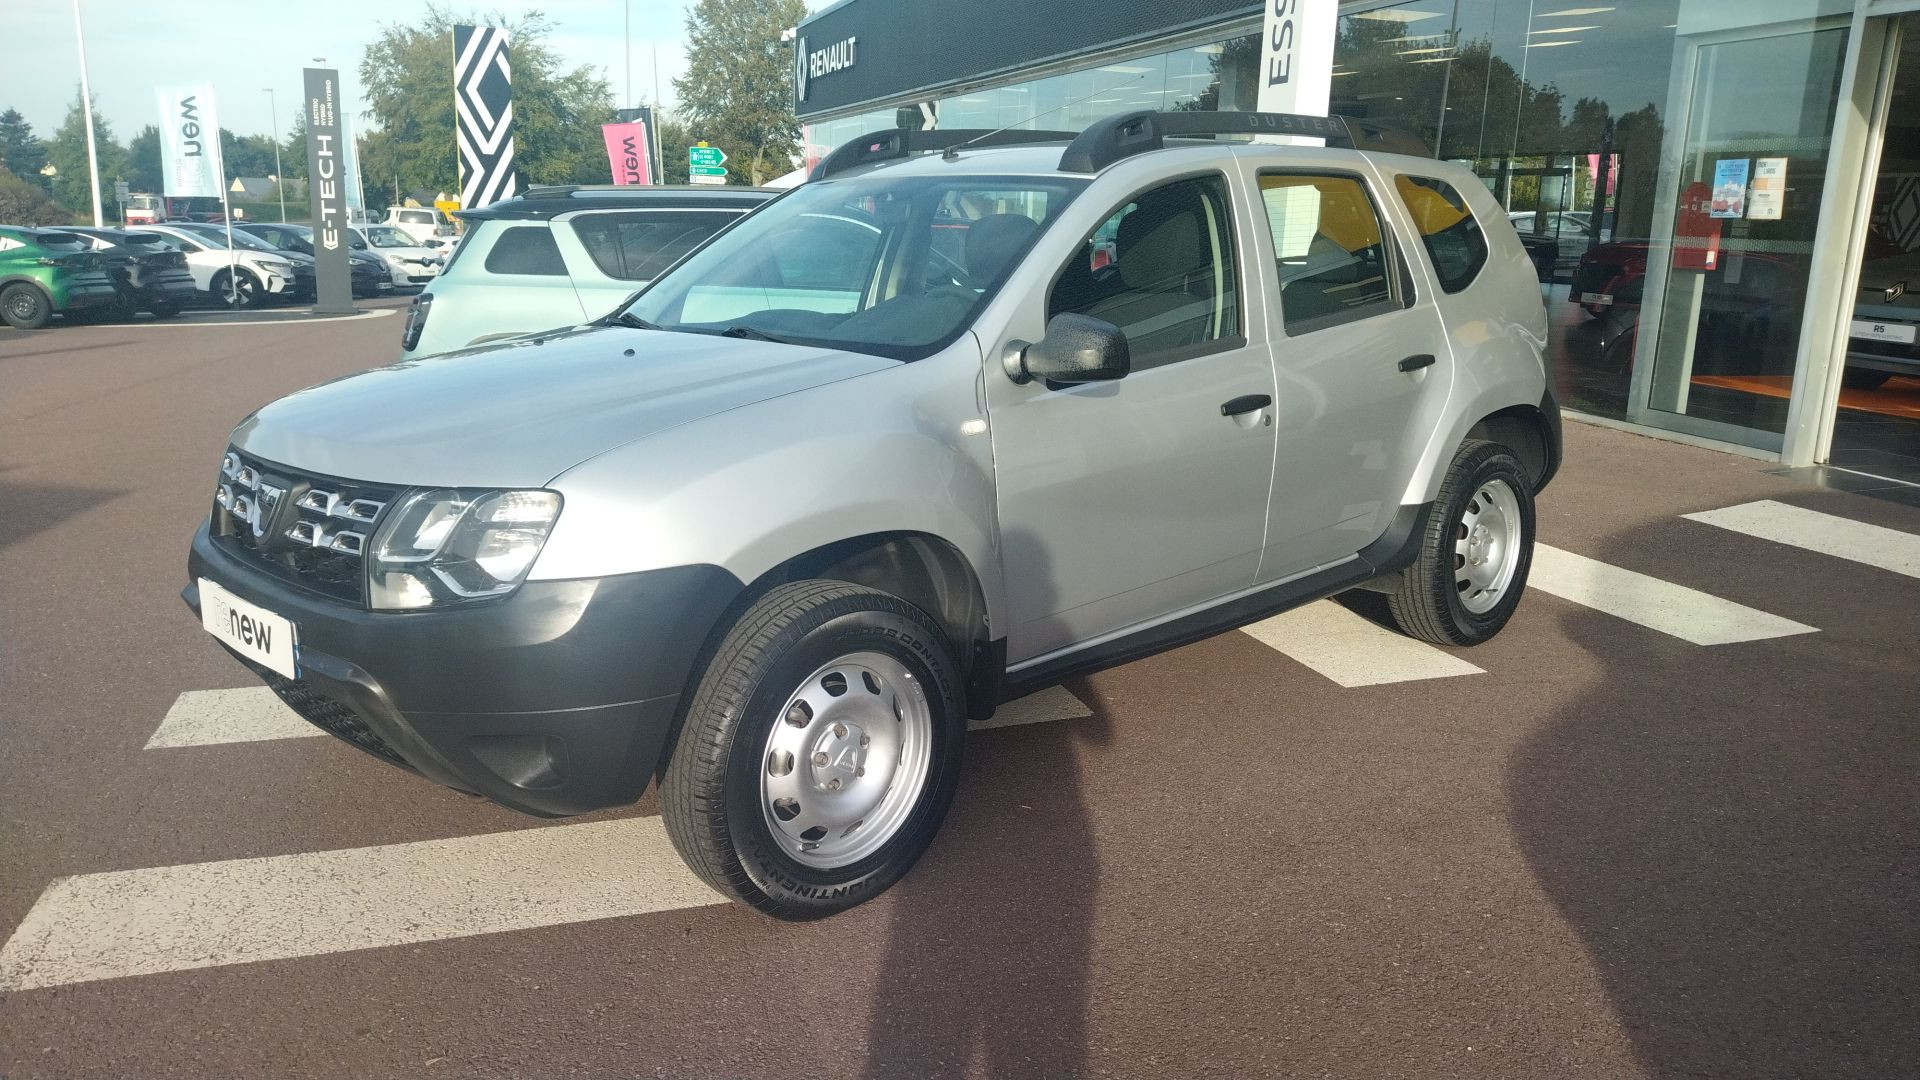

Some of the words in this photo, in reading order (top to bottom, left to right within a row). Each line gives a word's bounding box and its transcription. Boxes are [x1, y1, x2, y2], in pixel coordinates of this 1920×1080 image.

[810, 36, 856, 79] RENAULT
[1248, 114, 1339, 132] DUSTER
[317, 135, 339, 250] E-TECH
[1874, 325, 1885, 333] R5
[230, 607, 271, 654] new
